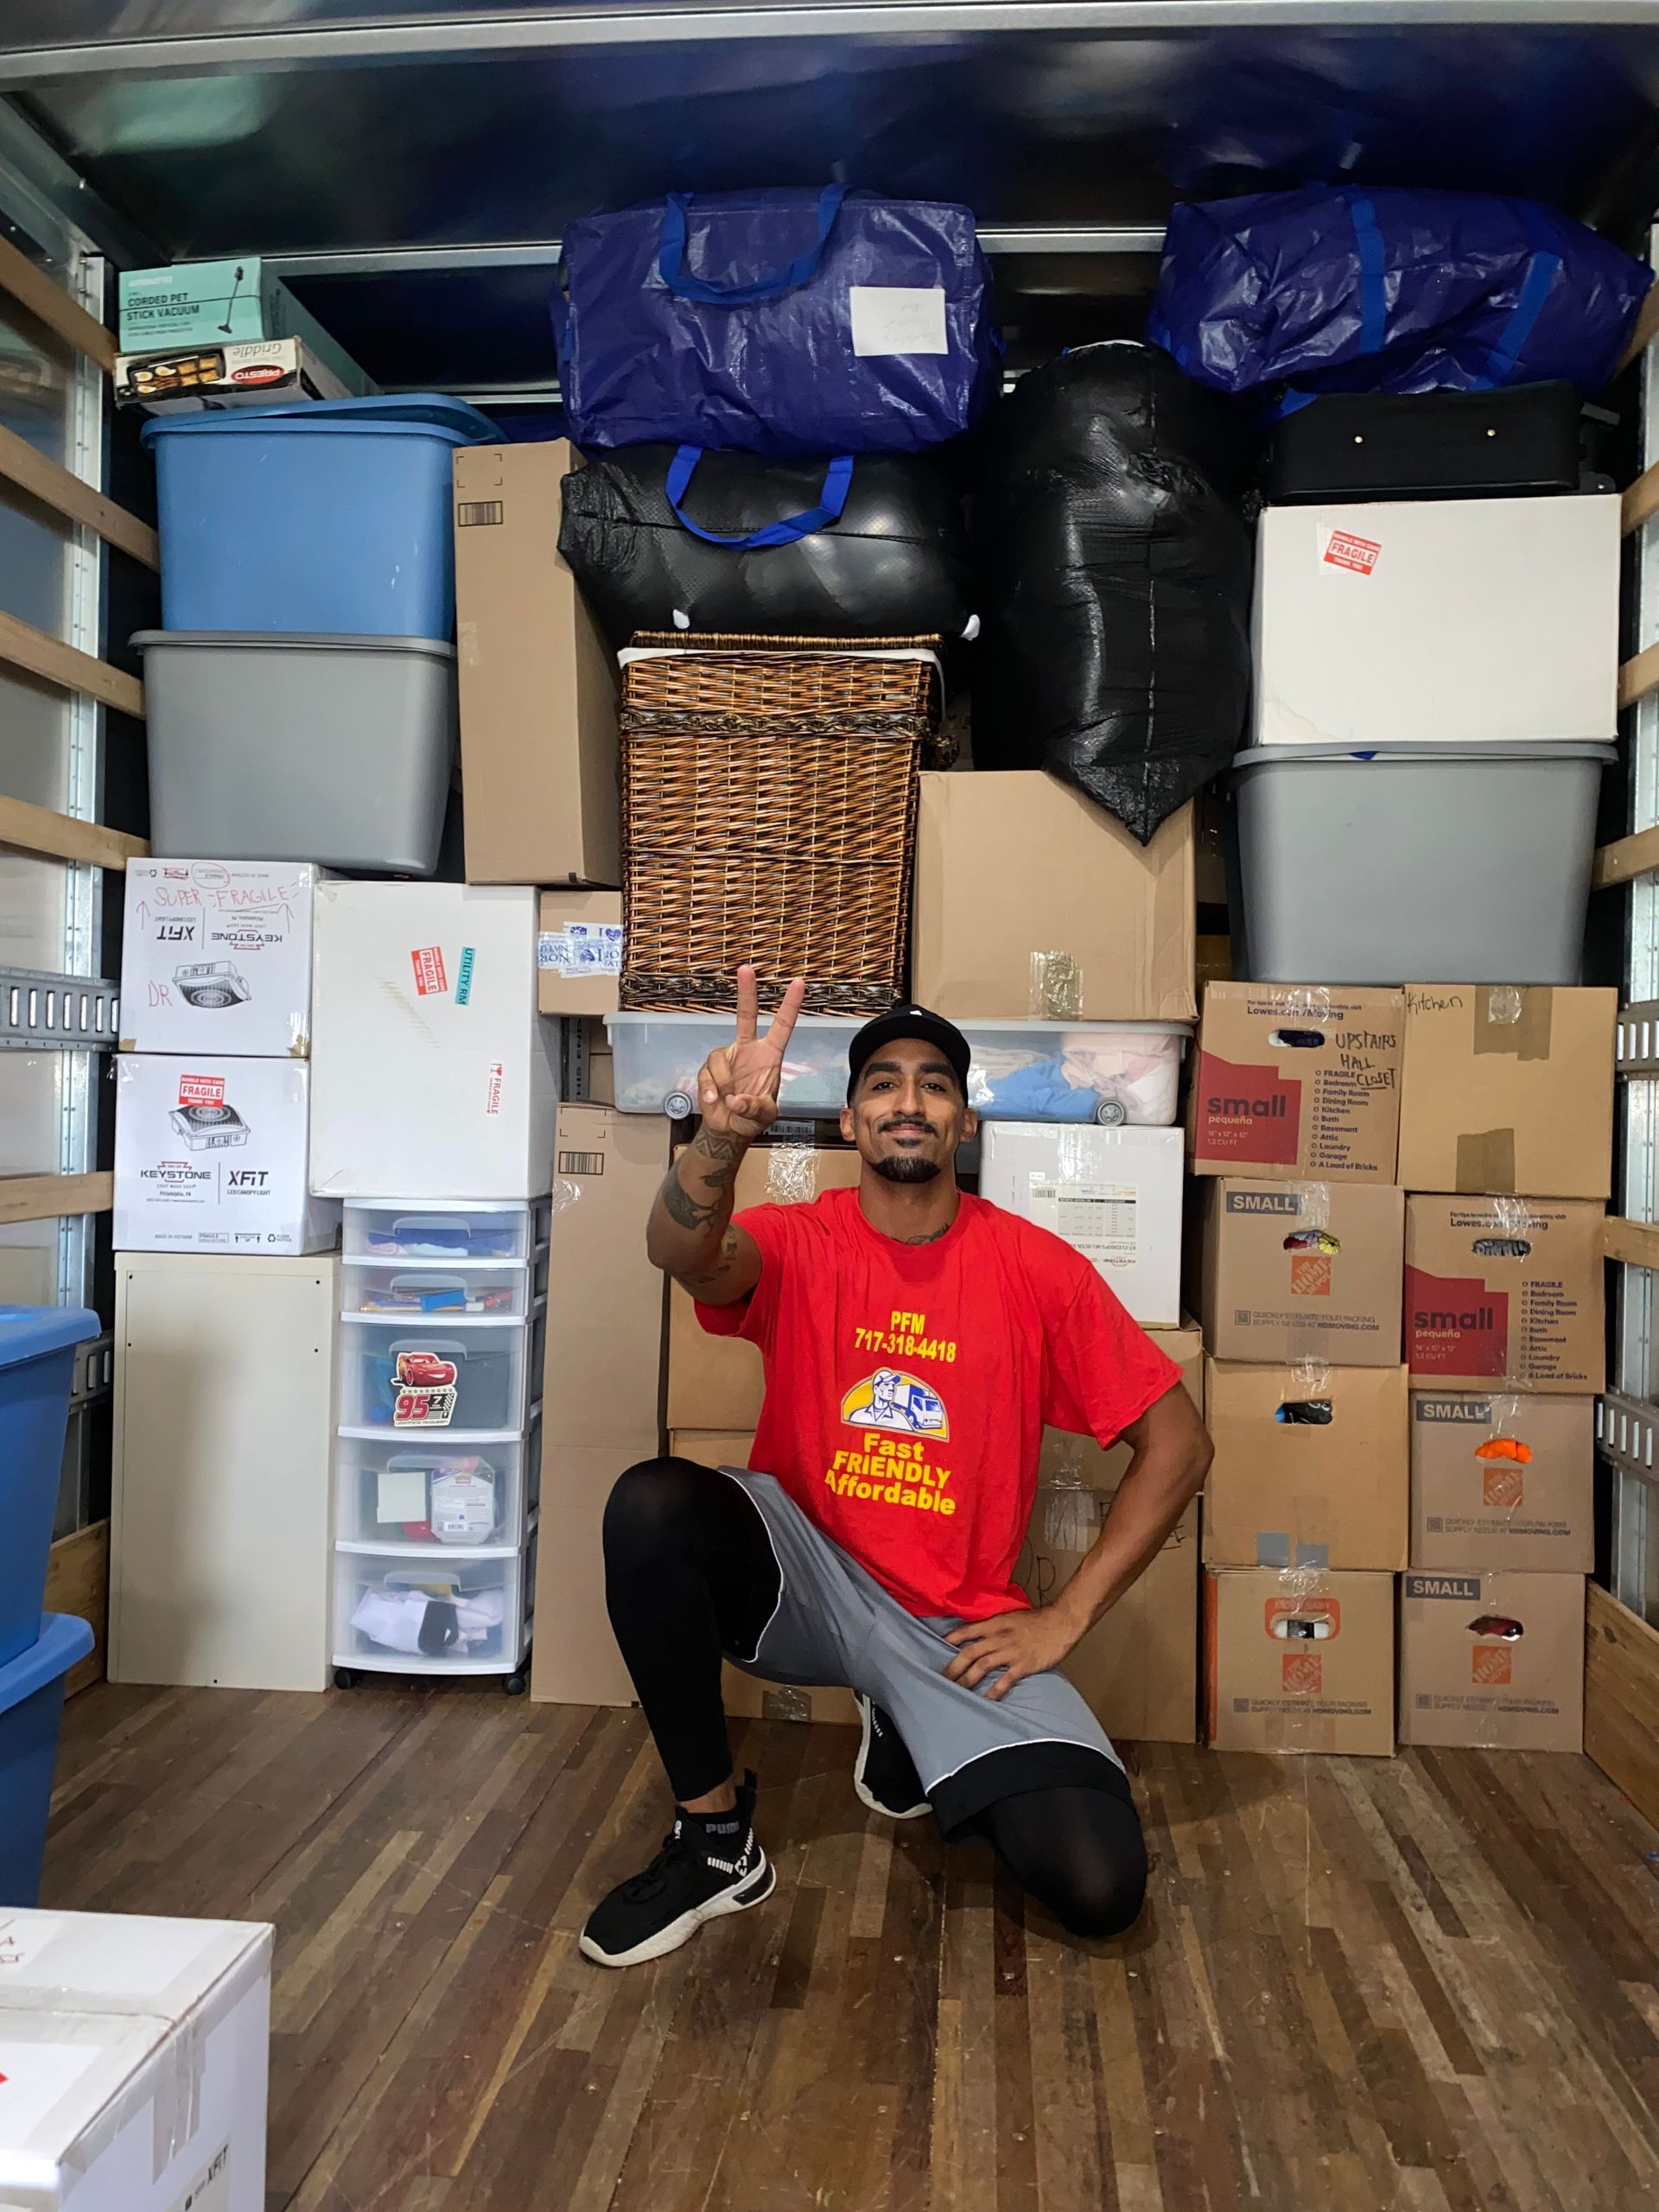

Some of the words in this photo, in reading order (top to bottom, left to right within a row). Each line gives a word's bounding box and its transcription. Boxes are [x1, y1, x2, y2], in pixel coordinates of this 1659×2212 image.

[128, 295, 168, 307] CORDED
[170, 292, 188, 302] PET
[127, 311, 155, 321] STICK
[157, 305, 200, 317] VACUUM
[233, 343, 282, 358] Griddle
[235, 369, 281, 380] PRESTO
[1331, 542, 1374, 564] FRAGILE
[155, 887, 203, 907] SUPER
[211, 932, 283, 942] KEYSTONE
[421, 951, 437, 991] FRAGILE
[461, 948, 475, 986] UTILITY
[148, 980, 173, 1007] DR
[458, 988, 467, 1005] RM
[1407, 992, 1463, 1015] Kitchen
[1335, 1030, 1397, 1050] UPSTAIRS
[1340, 1053, 1376, 1071] HALL
[1356, 1068, 1396, 1089] CLOSET
[183, 1085, 221, 1097] FRAGILE
[490, 1078, 502, 1114] FRAGILE
[1323, 1088, 1346, 1097] Family
[1208, 1094, 1286, 1118] small
[1322, 1097, 1346, 1106] Dining
[1208, 1116, 1253, 1125] pequeña
[1321, 1125, 1358, 1133] Basement
[1320, 1143, 1351, 1151] Laundry
[1319, 1152, 1347, 1160] Garage
[140, 1170, 211, 1179] KEYSTONE
[1233, 1195, 1295, 1211] SMALL
[1414, 1307, 1493, 1330] small
[1530, 1308, 1554, 1316] Dining
[890, 1311, 925, 1335] PFM
[1317, 1323, 1379, 1331] HDMOVING.COM
[1416, 1329, 1461, 1339] pequeña
[855, 1328, 957, 1363] 717-318-4418
[395, 1393, 430, 1421] 95
[432, 1396, 442, 1404] 7
[1423, 1404, 1485, 1420] SMALL
[864, 1432, 925, 1462] Fast
[832, 1450, 951, 1490] FRIENDLY
[824, 1469, 956, 1516] Affordable
[1413, 1581, 1474, 1596] SMALL
